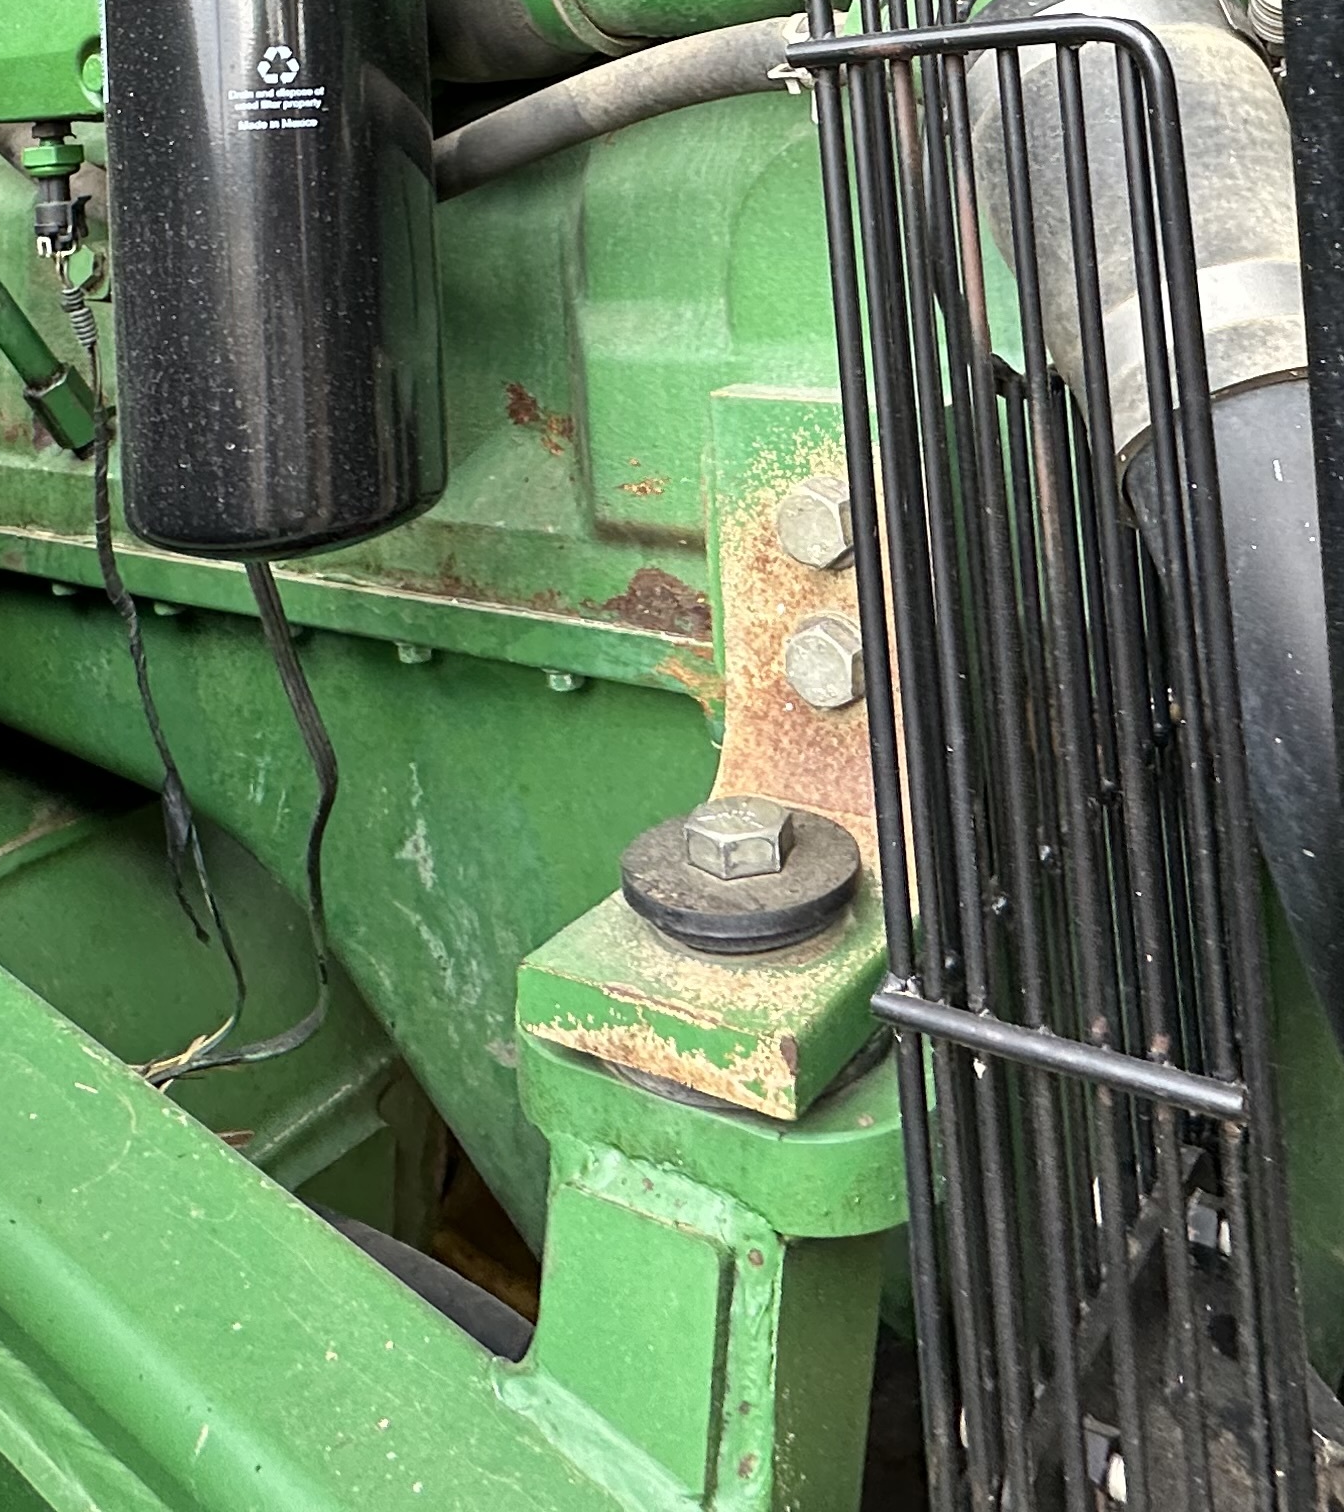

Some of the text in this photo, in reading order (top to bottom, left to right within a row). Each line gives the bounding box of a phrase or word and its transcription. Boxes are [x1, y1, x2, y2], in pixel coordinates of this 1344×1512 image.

[256, 89, 274, 99] and
[276, 88, 313, 99] dispose
[314, 87, 324, 96] of
[235, 99, 322, 110] used filter properly
[238, 118, 318, 130] Made in Mexico
